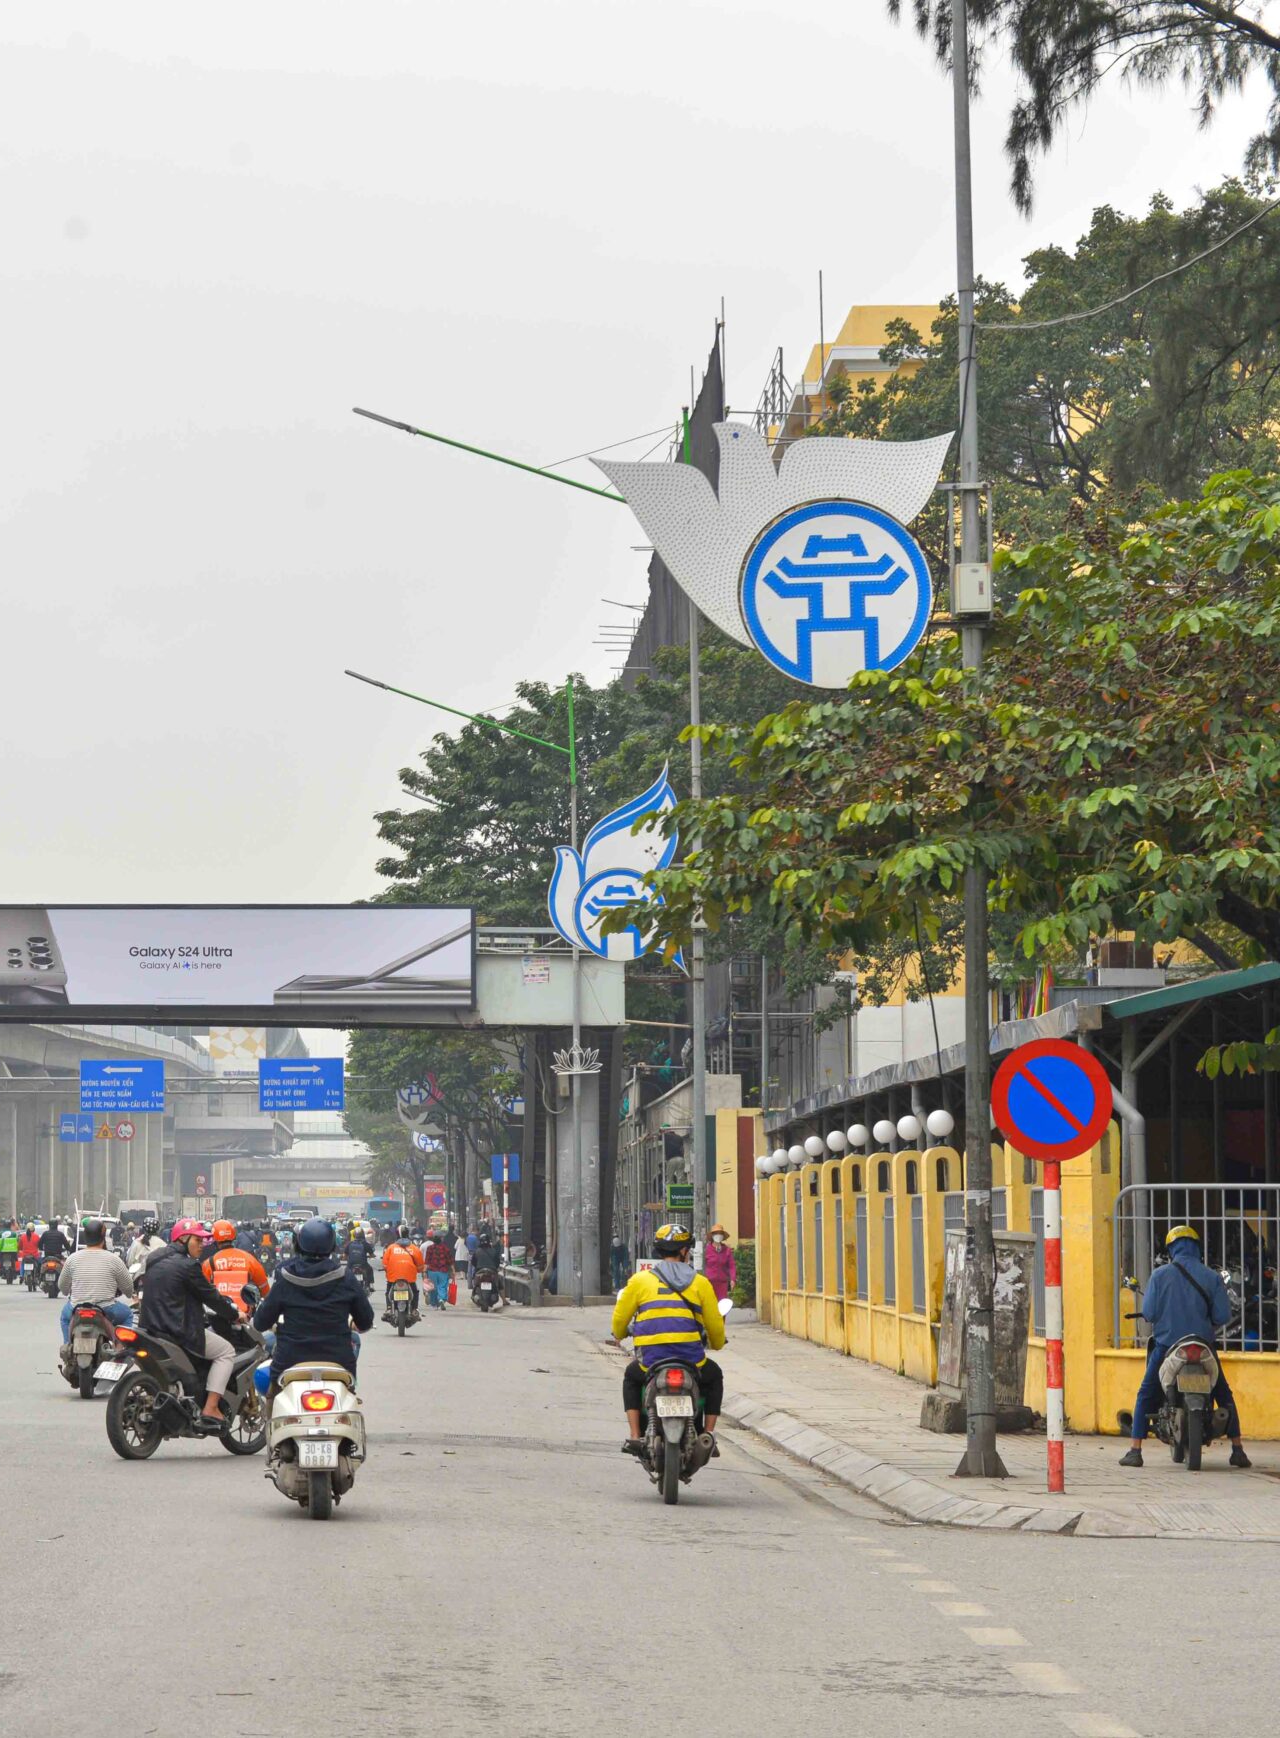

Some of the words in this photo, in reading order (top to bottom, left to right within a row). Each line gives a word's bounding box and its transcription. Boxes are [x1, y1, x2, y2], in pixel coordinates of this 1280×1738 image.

[129, 946, 176, 959] Galaxy
[178, 946, 200, 957] S24
[202, 946, 233, 957] Ultra
[139, 961, 171, 971] Galaxy
[172, 961, 181, 970] AI
[191, 961, 199, 970] is
[201, 961, 222, 970] here
